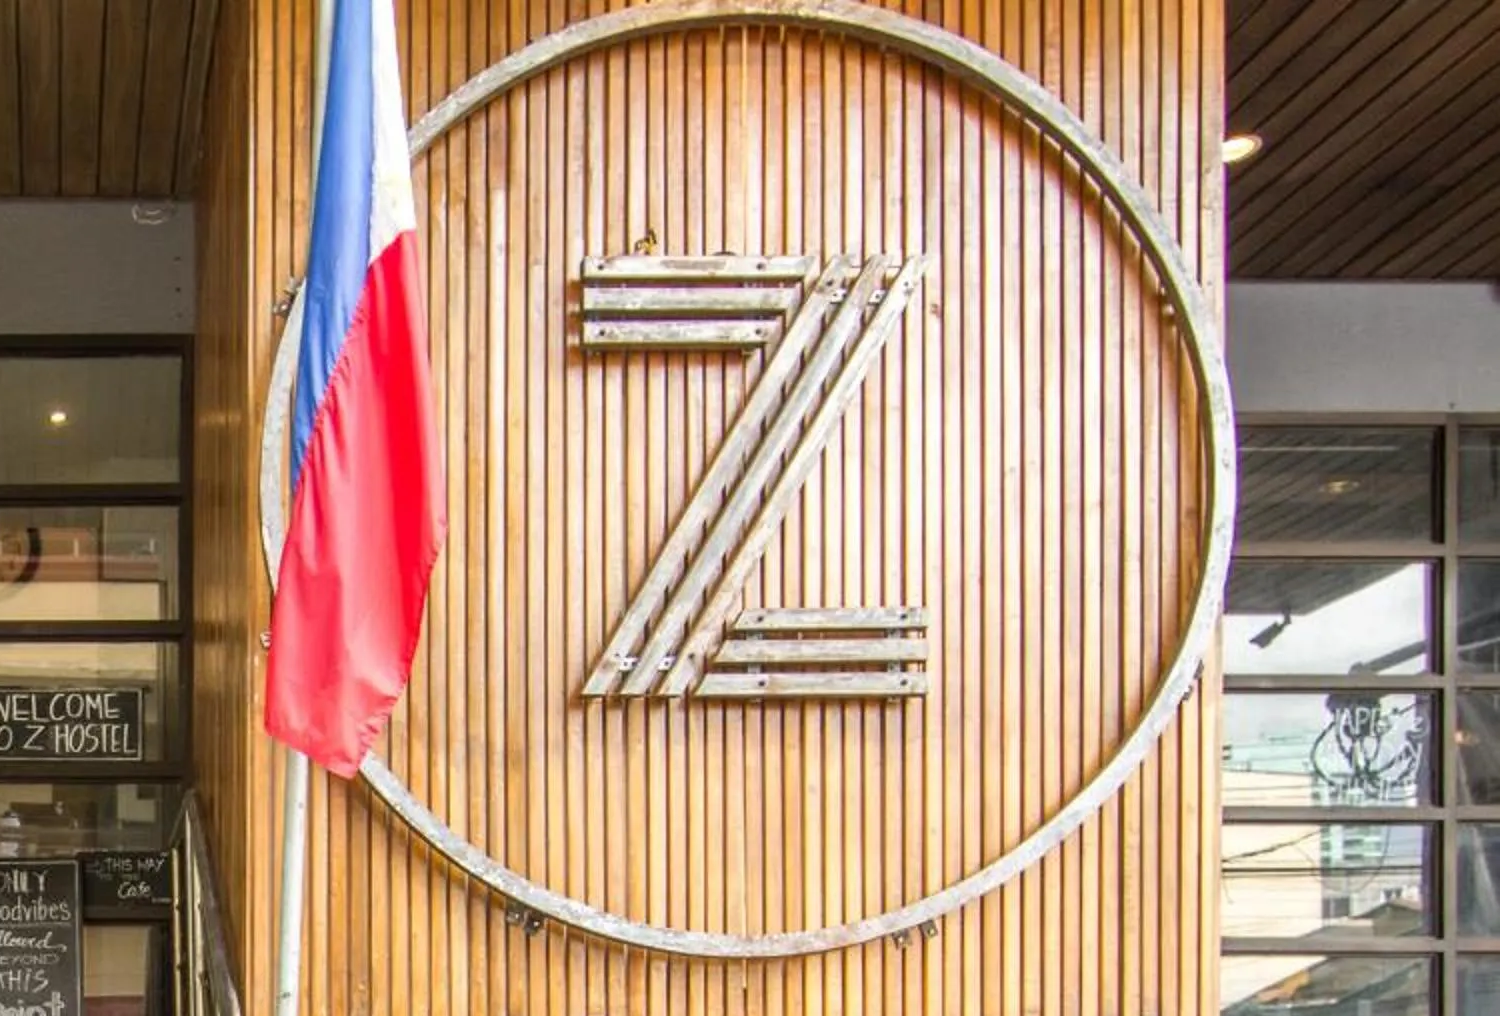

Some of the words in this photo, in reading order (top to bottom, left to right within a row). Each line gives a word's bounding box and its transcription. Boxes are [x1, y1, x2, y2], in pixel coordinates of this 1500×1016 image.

[580, 254, 930, 699] Z
[22, 724, 45, 751] Z
[54, 723, 137, 754] HOSTEL
